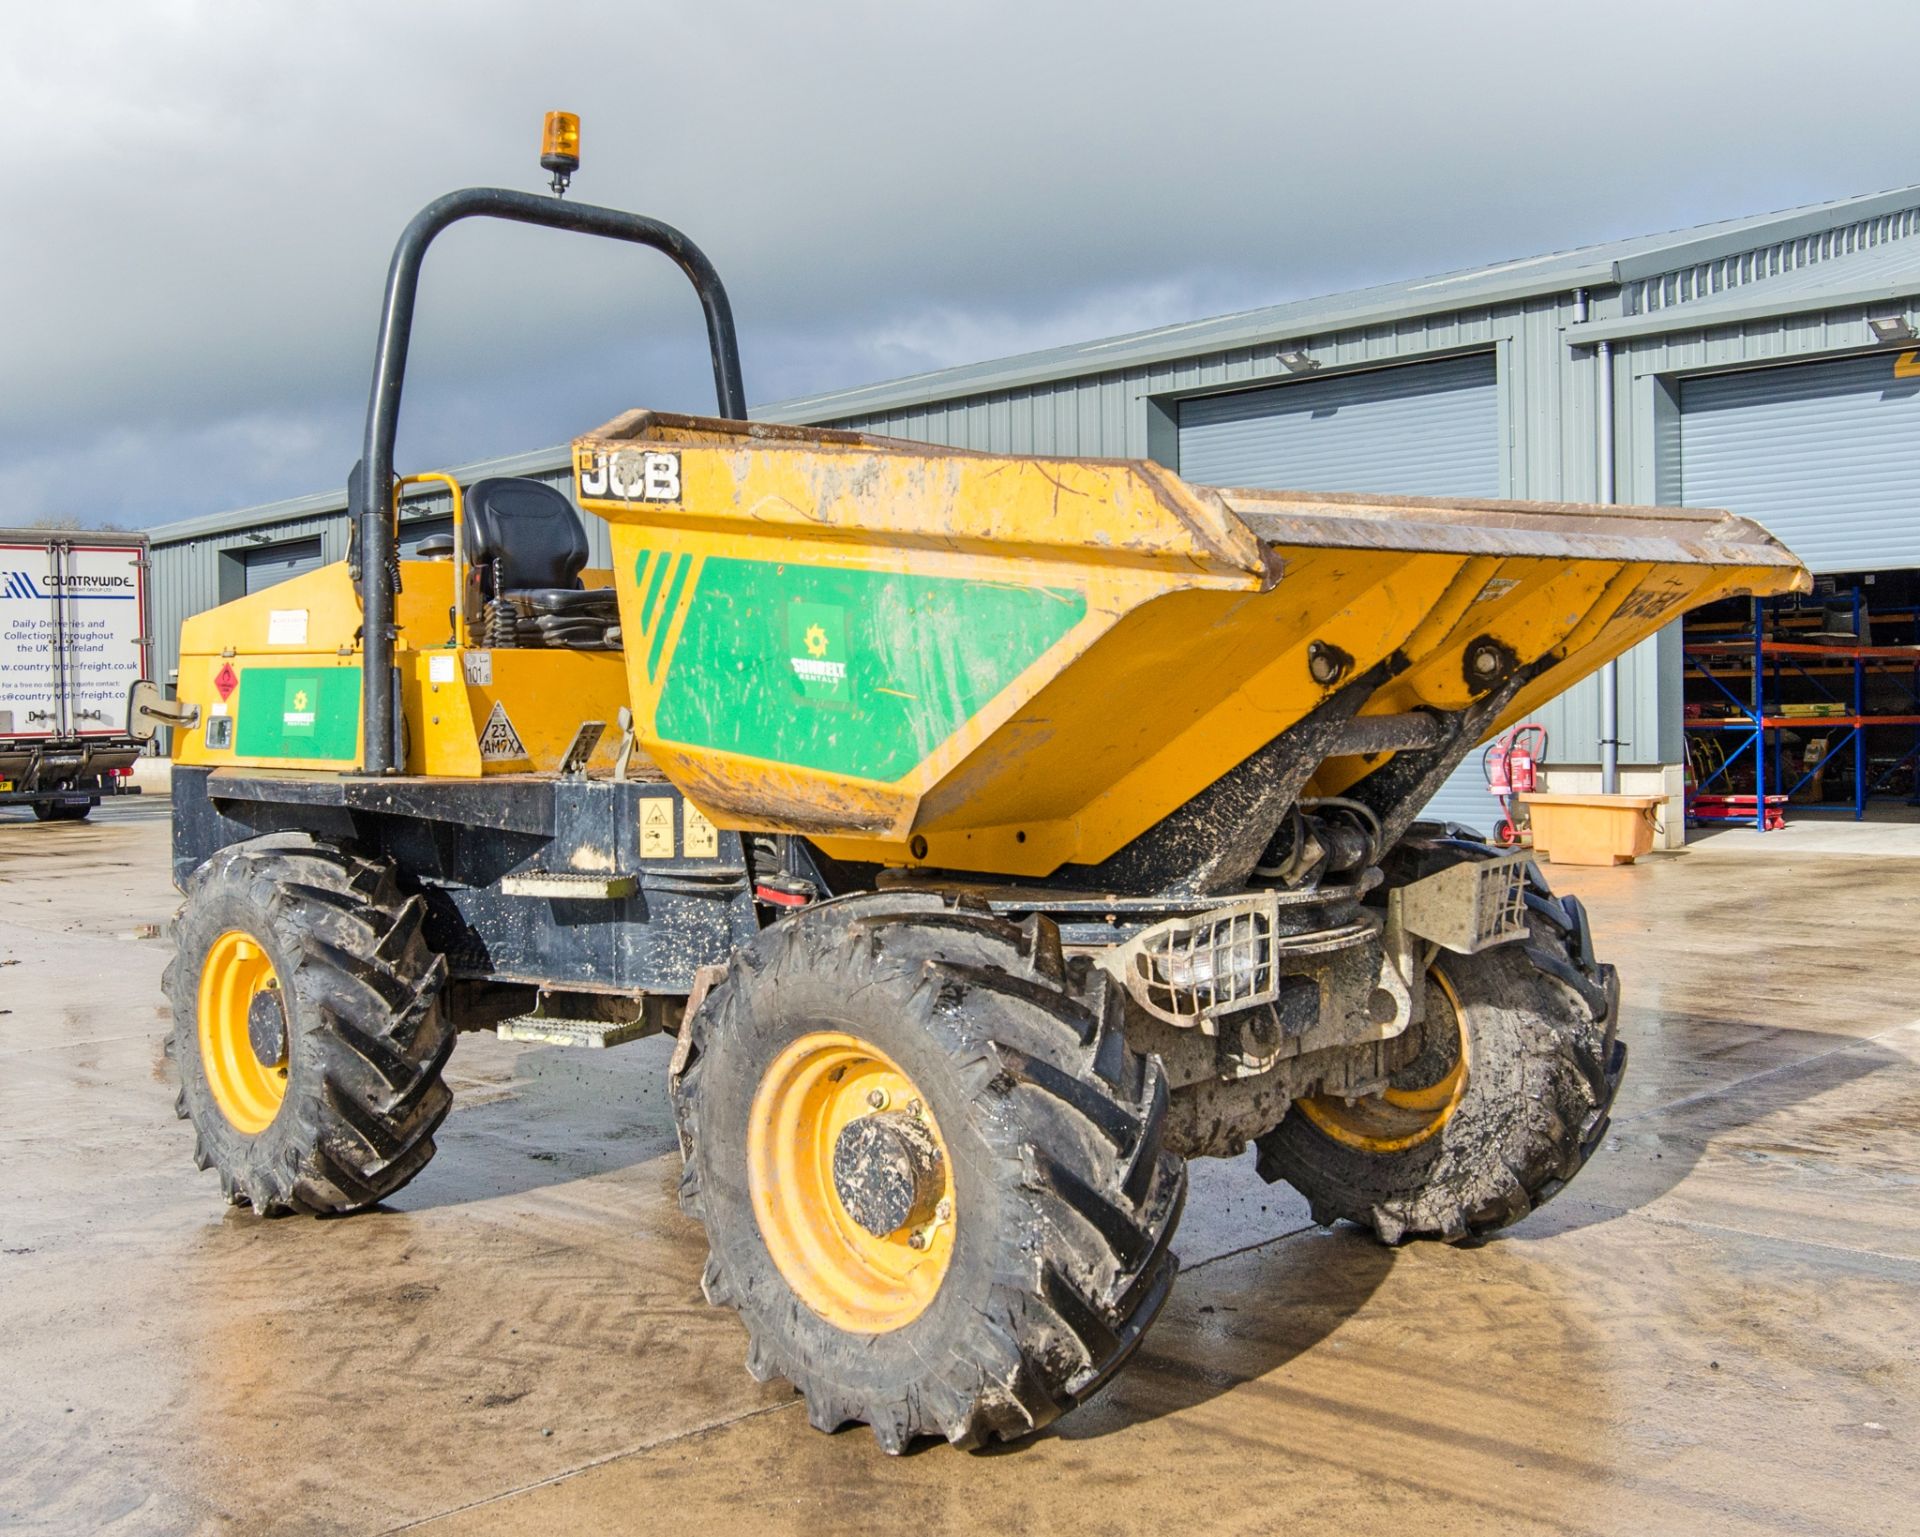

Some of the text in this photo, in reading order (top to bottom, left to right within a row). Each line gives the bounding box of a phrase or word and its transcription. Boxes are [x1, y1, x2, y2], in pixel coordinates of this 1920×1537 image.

[582, 451, 680, 499] JCB
[42, 575, 134, 587] COUNTRYWIDE
[13, 620, 36, 629] Daily
[88, 620, 104, 628] and
[4, 632, 114, 642] Collections hroughout
[72, 644, 104, 652] Ireland
[1, 661, 138, 672] w.countrywde-freight.co.uk
[468, 666, 481, 682] 101
[491, 724, 507, 738] 23
